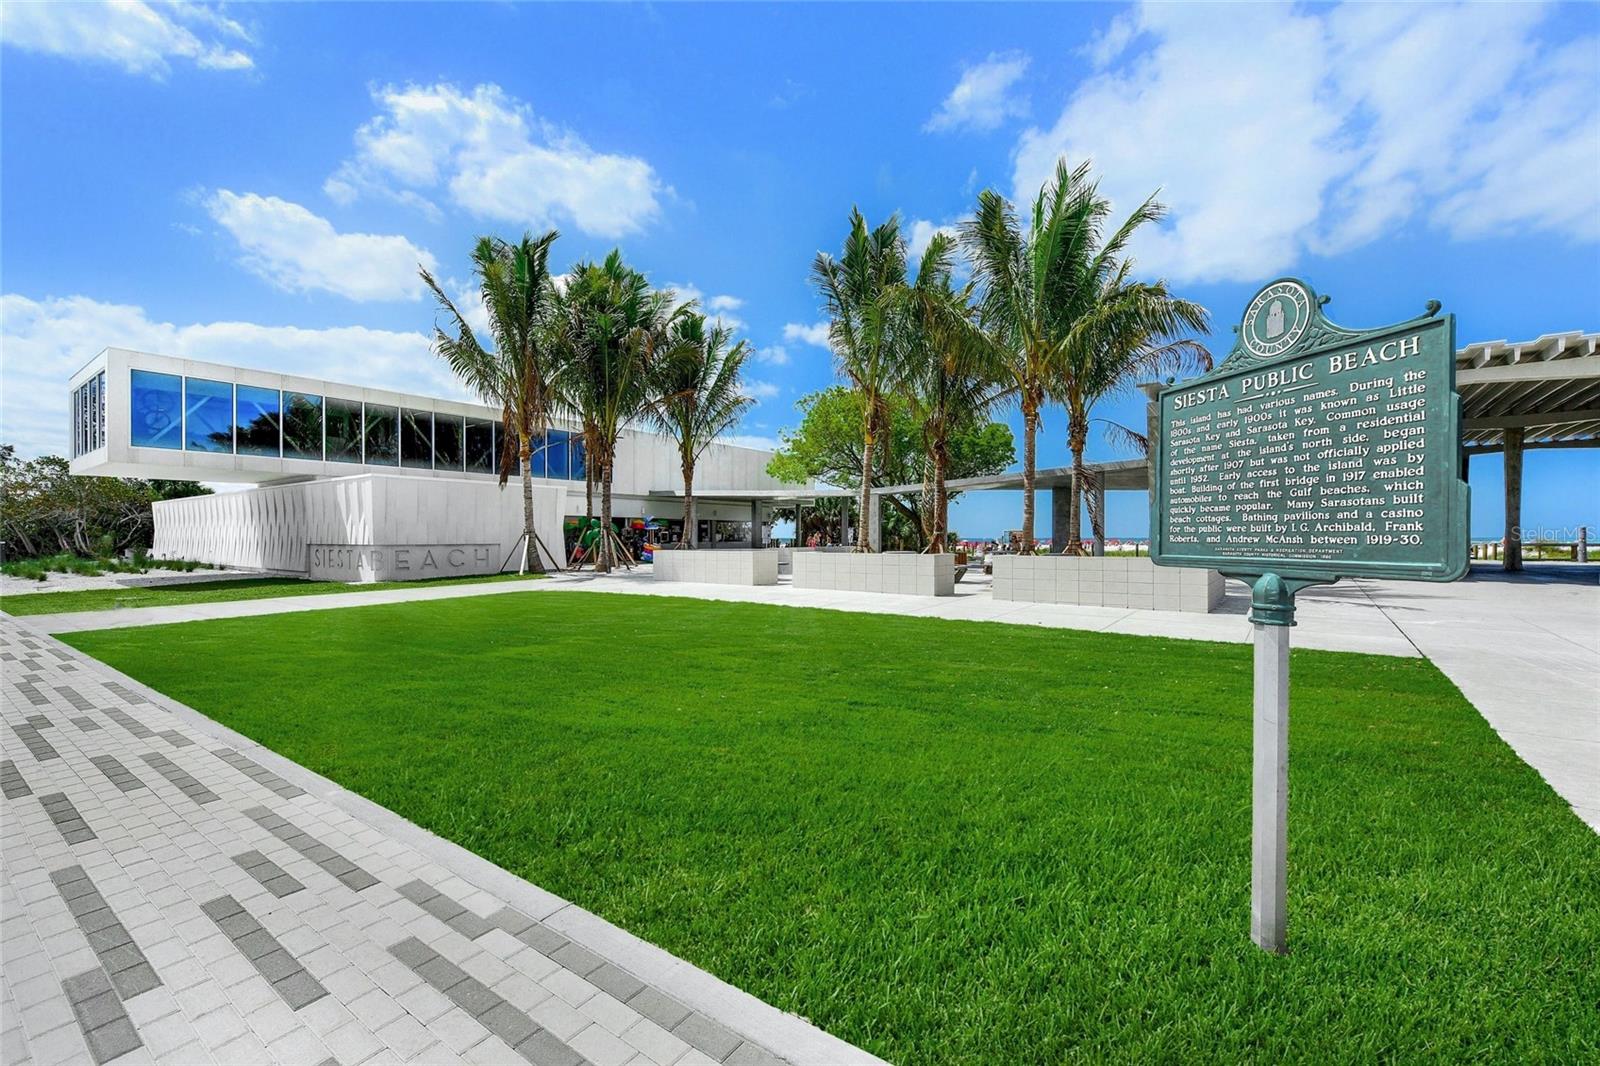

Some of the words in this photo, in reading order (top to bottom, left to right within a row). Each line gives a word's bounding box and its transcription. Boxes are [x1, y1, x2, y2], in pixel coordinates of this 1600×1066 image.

[1245, 285, 1306, 326] SARASOTA
[1250, 325, 1301, 353] COUNTY
[1174, 384, 1229, 410] SIESTA
[1241, 363, 1313, 394] PUBLIC
[1329, 336, 1419, 374] BEACH
[1170, 428, 1191, 437] 1800s
[1196, 424, 1210, 433] and
[1216, 419, 1238, 430] early
[1244, 412, 1272, 423] 1900s
[1279, 409, 1286, 417] it
[1294, 405, 1312, 415] was
[1321, 397, 1357, 410] known
[1366, 393, 1379, 402] as
[1389, 384, 1426, 398] Little
[1171, 420, 1185, 428] This
[1190, 413, 1211, 424] island
[1217, 409, 1231, 419] has
[1237, 405, 1252, 414] had
[1260, 396, 1295, 410] various
[1349, 377, 1393, 392] During
[1404, 370, 1426, 381] the
[1170, 437, 1200, 447] Sarasota
[1205, 432, 1220, 441] Key
[1225, 429, 1240, 437] and
[1247, 421, 1287, 435] Sarasota
[1326, 407, 1376, 421] Common
[1386, 398, 1425, 411] usage
[1170, 448, 1178, 457] of
[1183, 446, 1195, 454] the
[1201, 443, 1222, 452] name
[1267, 432, 1295, 442] taken
[1303, 427, 1329, 437] from
[1356, 410, 1425, 429] residential
[1170, 454, 1215, 466] development
[1237, 449, 1251, 457] the
[1302, 437, 1332, 448] north
[1383, 426, 1424, 439] began
[1170, 466, 1195, 475] shortly
[1200, 463, 1219, 472] after
[1224, 460, 1244, 469] 1907
[1250, 458, 1264, 467] but
[1270, 456, 1287, 464] was
[1293, 452, 1310, 461] not
[1317, 446, 1369, 459] officially
[1376, 438, 1424, 453] applied
[1170, 477, 1186, 485] until
[1219, 472, 1240, 481] Early
[1247, 468, 1277, 478] access
[1284, 466, 1295, 474] to
[1303, 464, 1320, 472] the
[1328, 458, 1362, 470] island
[1373, 457, 1396, 466] was
[1407, 452, 1424, 463] by
[1191, 484, 1222, 493] Building
[1227, 482, 1235, 490] of
[1240, 480, 1255, 489] the
[1260, 479, 1279, 488] first
[1285, 475, 1319, 486] bridge
[1325, 473, 1335, 482] in
[1343, 471, 1366, 481] 1917
[1373, 465, 1424, 479] enabled
[1170, 495, 1212, 504] automobiles
[1234, 491, 1258, 500] reach
[1267, 490, 1282, 498] the
[1290, 487, 1312, 497] Gulf
[1384, 480, 1423, 491] which
[1170, 505, 1196, 515] quickly
[1200, 504, 1231, 512] became
[1235, 502, 1273, 512] popular.
[1287, 500, 1314, 510] Many
[1320, 497, 1385, 507] Sarasotans
[1393, 493, 1424, 504] built
[1169, 525, 1180, 533] for
[1184, 525, 1195, 533] the
[1198, 525, 1222, 533] public
[1250, 523, 1271, 532] built
[1275, 523, 1287, 534] by
[1385, 521, 1423, 531] Frank
[1170, 514, 1191, 523] beach
[1242, 513, 1278, 522] Bathing
[1284, 511, 1329, 521] pavilions
[1336, 510, 1358, 519] and
[1381, 508, 1423, 518] casino
[1206, 535, 1220, 543] and
[1226, 535, 1260, 543] Andrew
[1265, 535, 1303, 544] McAnsh
[1310, 535, 1357, 544] between
[314, 549, 365, 570] SIESTA
[370, 548, 489, 571] BEACH
